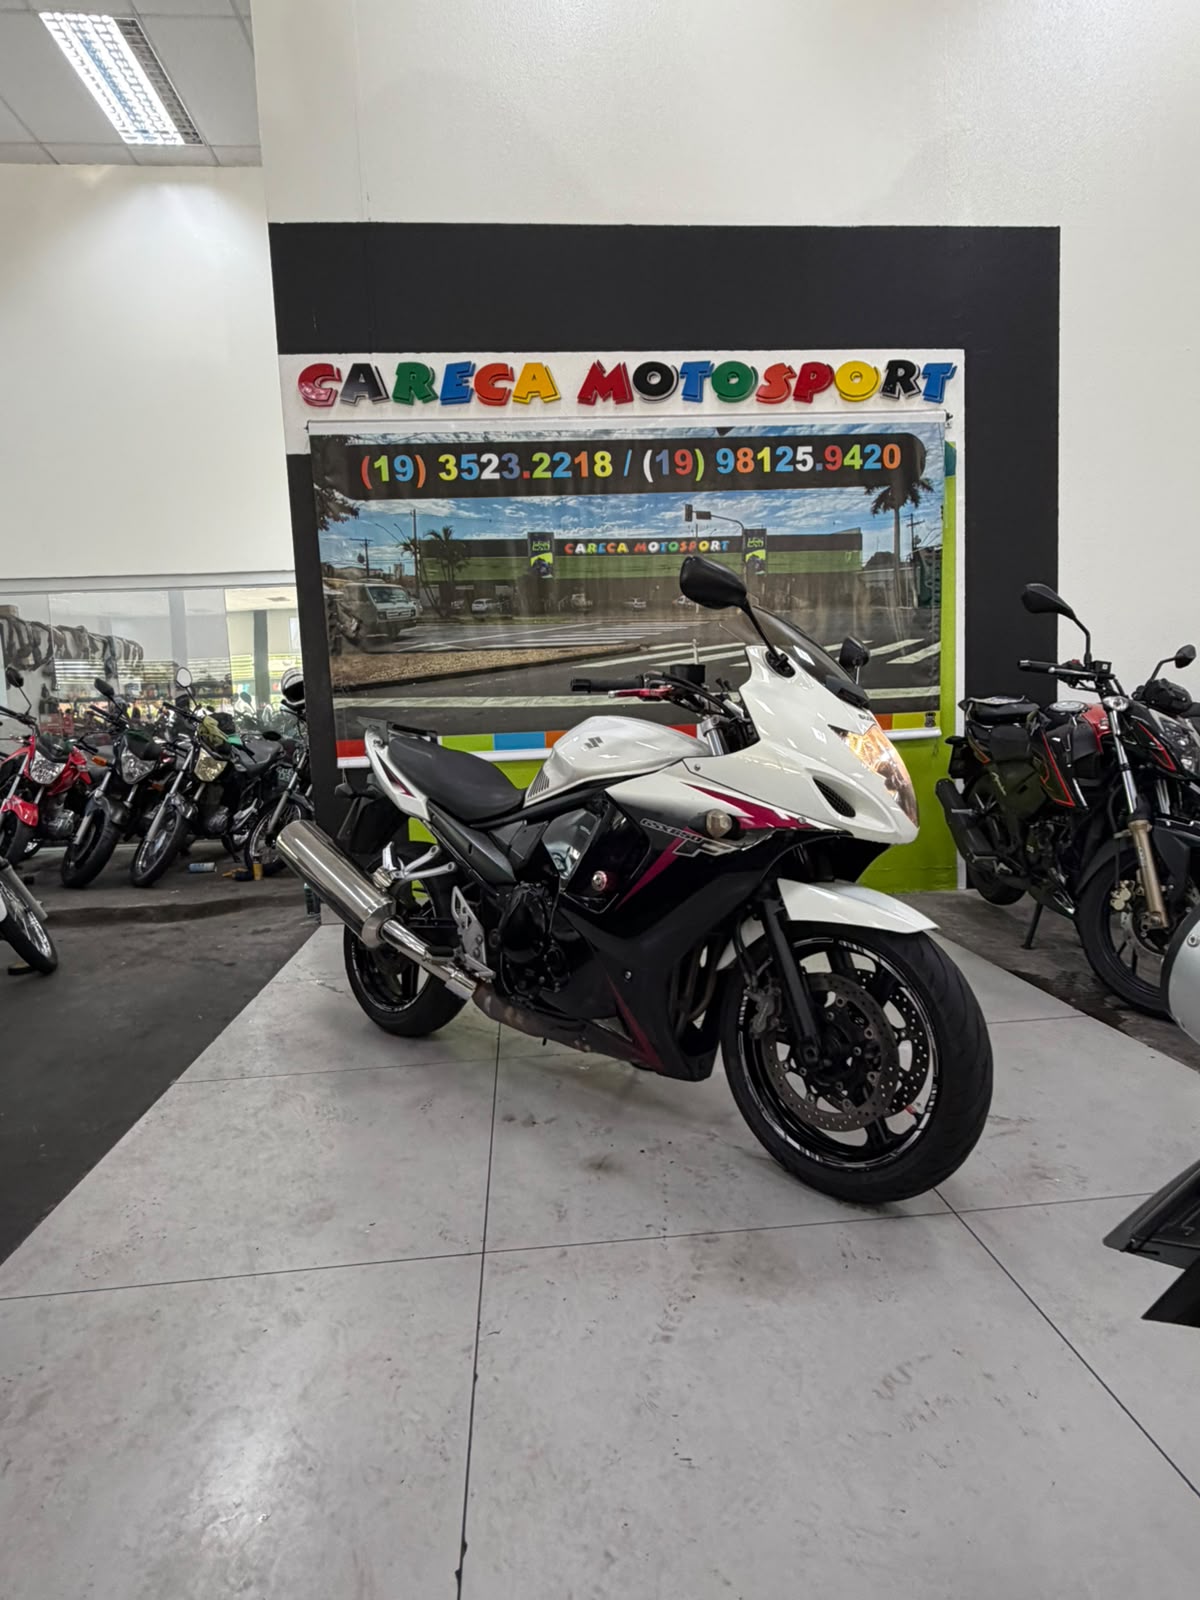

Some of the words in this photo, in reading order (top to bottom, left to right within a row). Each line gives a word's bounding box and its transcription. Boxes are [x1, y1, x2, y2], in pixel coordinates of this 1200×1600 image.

[298, 360, 561, 407] CARECA
[577, 359, 958, 405] MOTOSPORT
[360, 454, 427, 490] (19)
[438, 451, 613, 481] 3523.2218
[642, 448, 705, 483] (19)
[716, 443, 901, 474] 98125.9420
[564, 542, 629, 554] CARECA
[633, 540, 730, 554] MOTOSPORT
